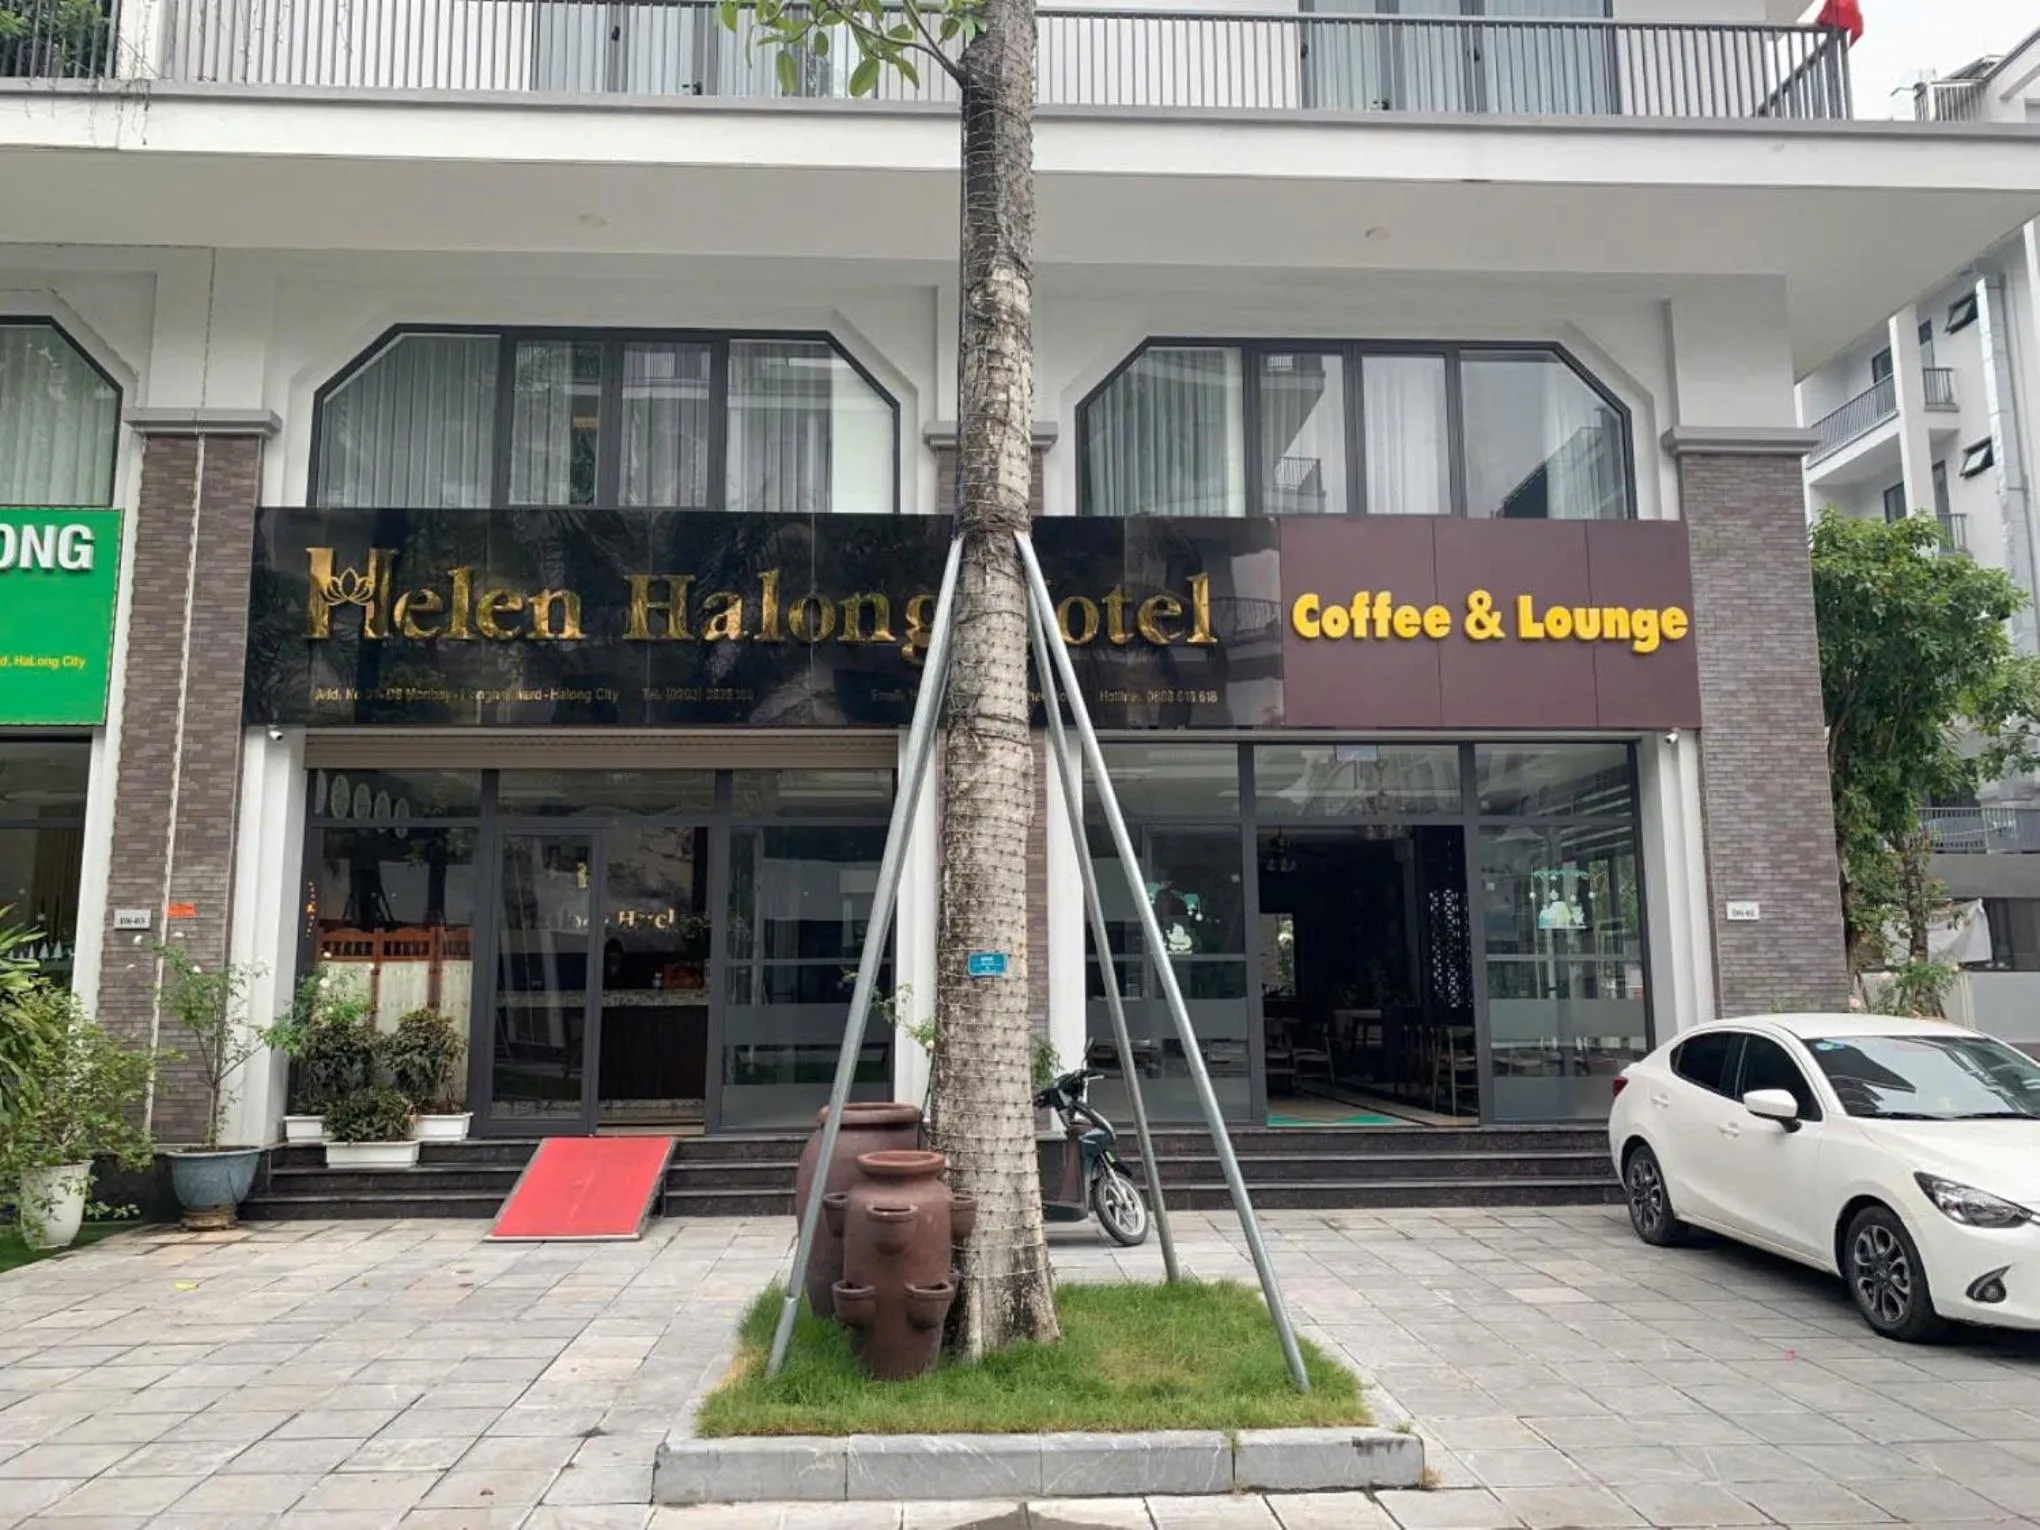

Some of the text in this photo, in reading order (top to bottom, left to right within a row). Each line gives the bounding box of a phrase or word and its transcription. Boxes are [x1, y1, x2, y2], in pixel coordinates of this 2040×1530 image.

[303, 547, 586, 640] Helen
[1055, 572, 1218, 645] otel
[1292, 589, 1689, 654] Coffee & Lounge
[63, 655, 86, 670] City
